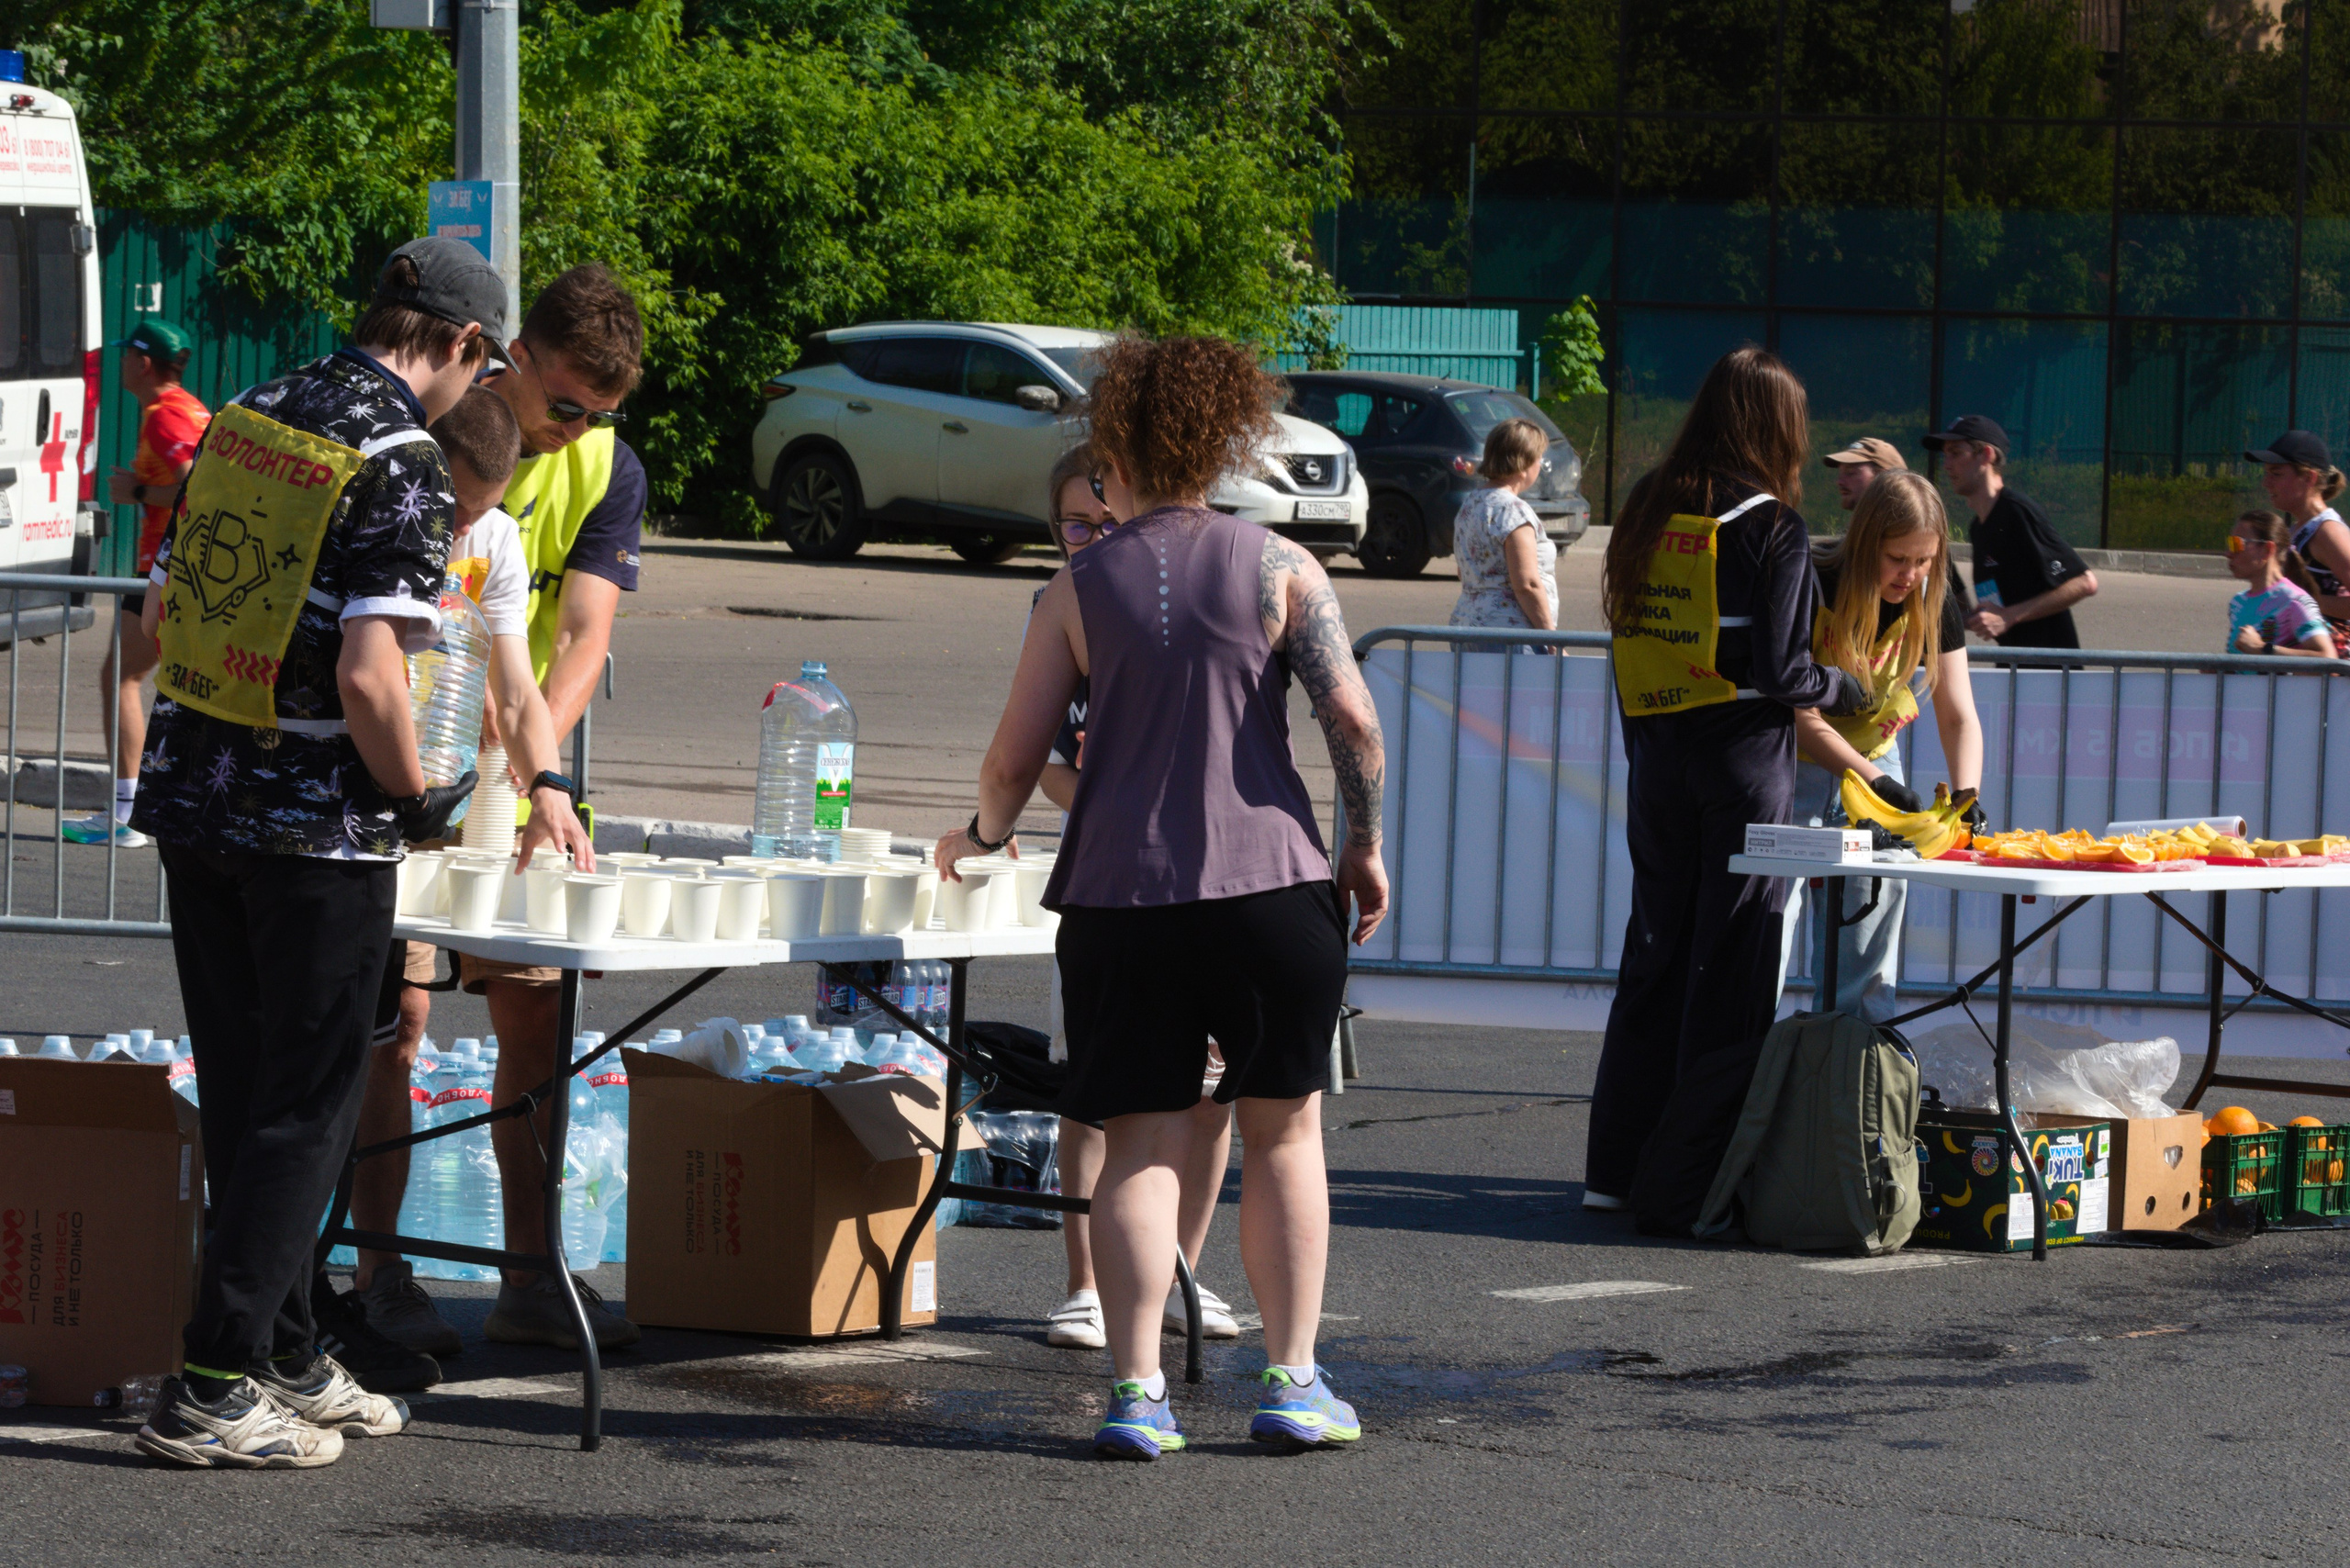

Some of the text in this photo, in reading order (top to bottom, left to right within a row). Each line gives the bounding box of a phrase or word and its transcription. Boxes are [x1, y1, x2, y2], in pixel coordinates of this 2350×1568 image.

[208, 425, 334, 491] ВОЛОНТЕР
[22, 511, 73, 543] rammedic.ru
[437, 1089, 484, 1103] УДОБНО
[2049, 1145, 2083, 1158] BANANA
[686, 1162, 694, 1185] НЕ
[2048, 1158, 2084, 1181] TUKI
[686, 1190, 694, 1254] ТОЛЬКО
[70, 1211, 84, 1283] ТОЛЬКО
[2062, 1236, 2085, 1245] PRODUCT
[52, 1211, 69, 1327] ДЛЯ БИЗНЕСА
[69, 1287, 81, 1313] НЕ
